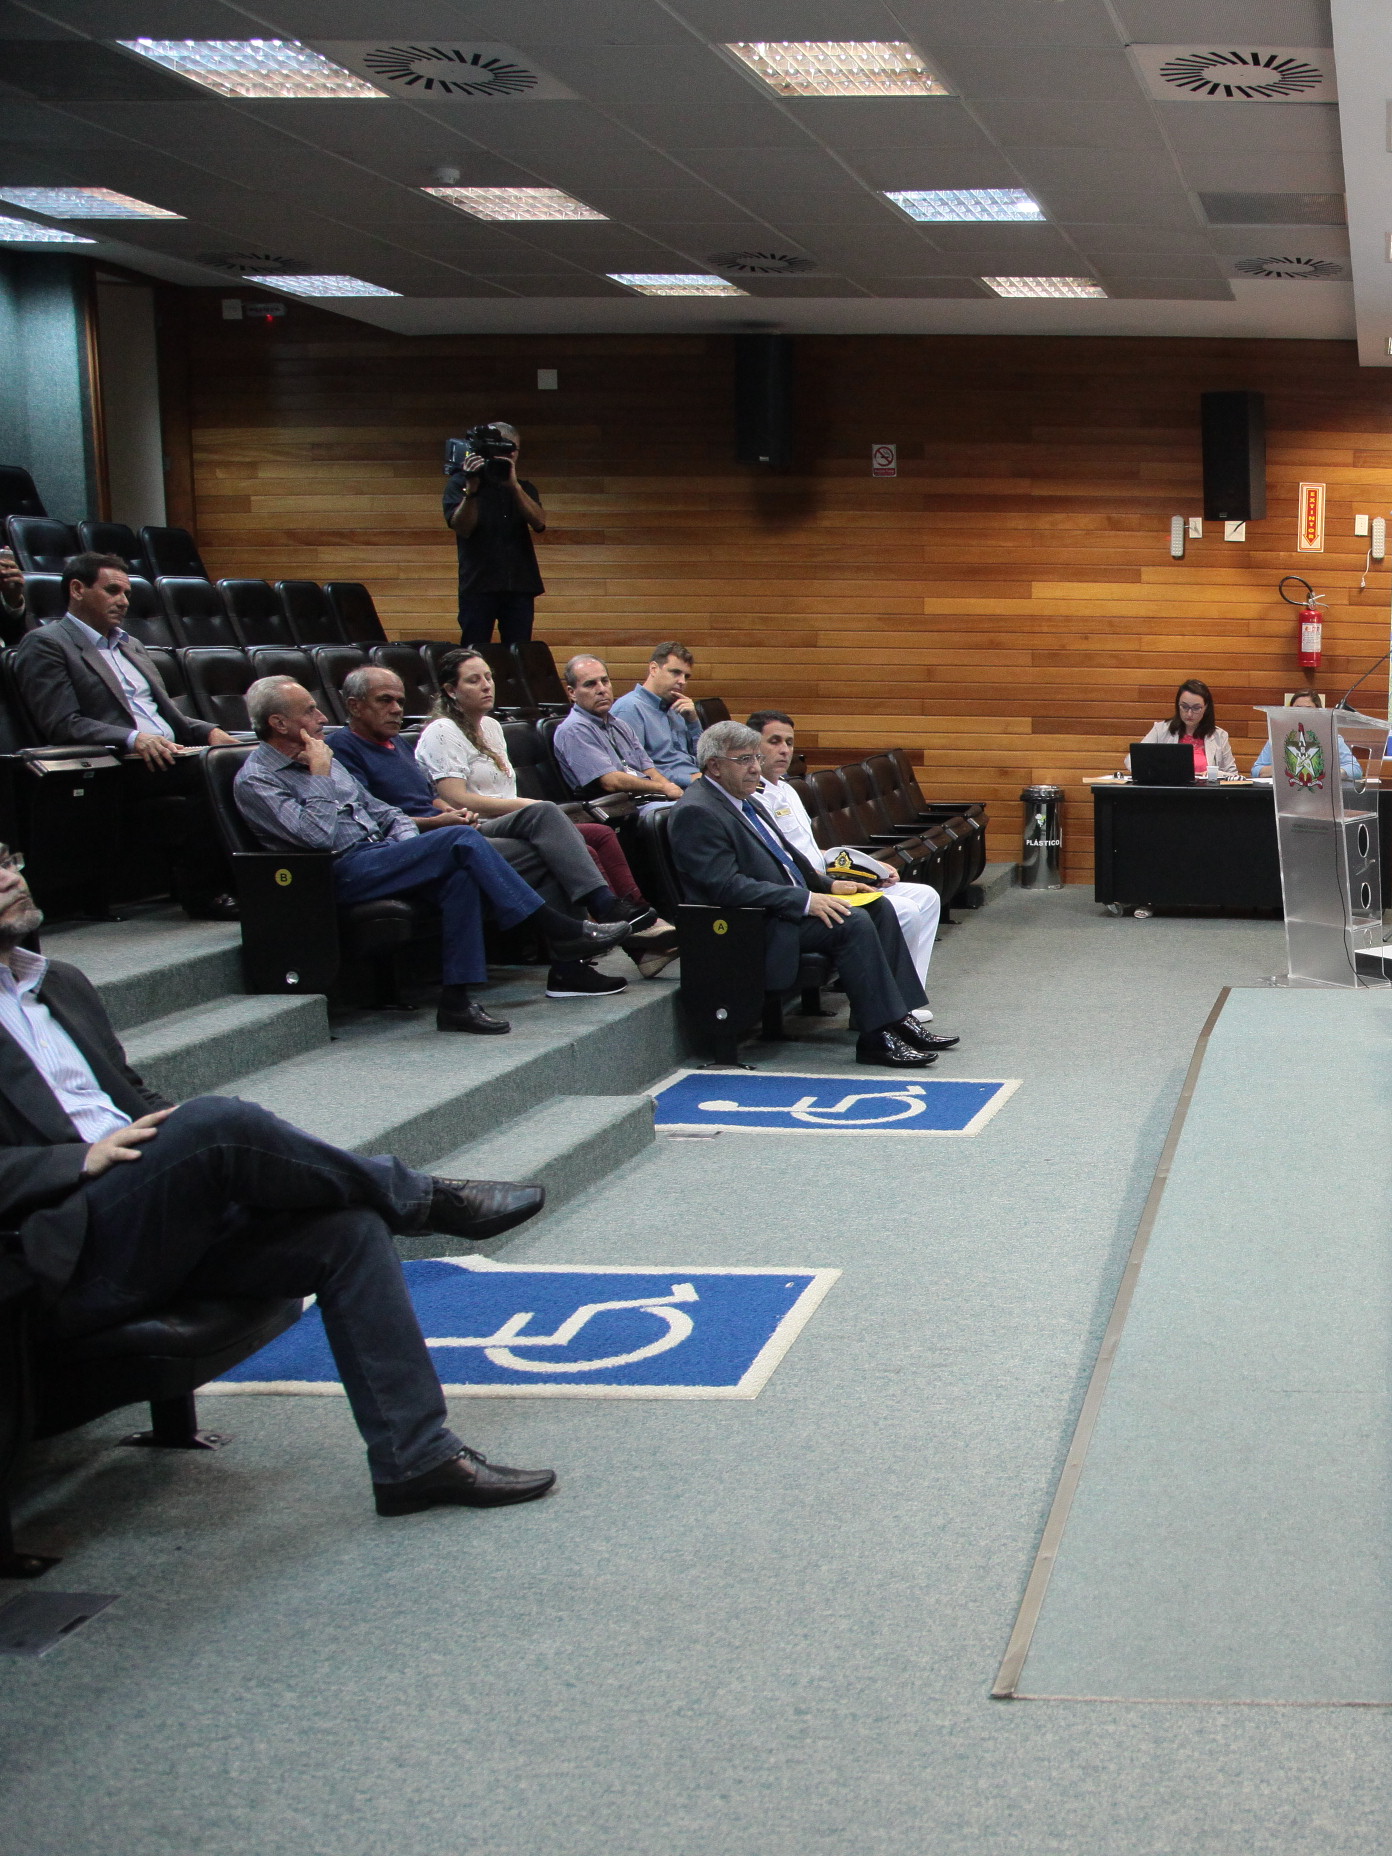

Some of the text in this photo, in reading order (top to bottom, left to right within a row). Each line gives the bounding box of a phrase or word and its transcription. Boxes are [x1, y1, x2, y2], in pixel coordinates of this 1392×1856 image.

[1308, 491, 1316, 539] EXTINTOR
[1026, 839, 1060, 847] PLÁSTICO
[280, 873, 288, 882] B
